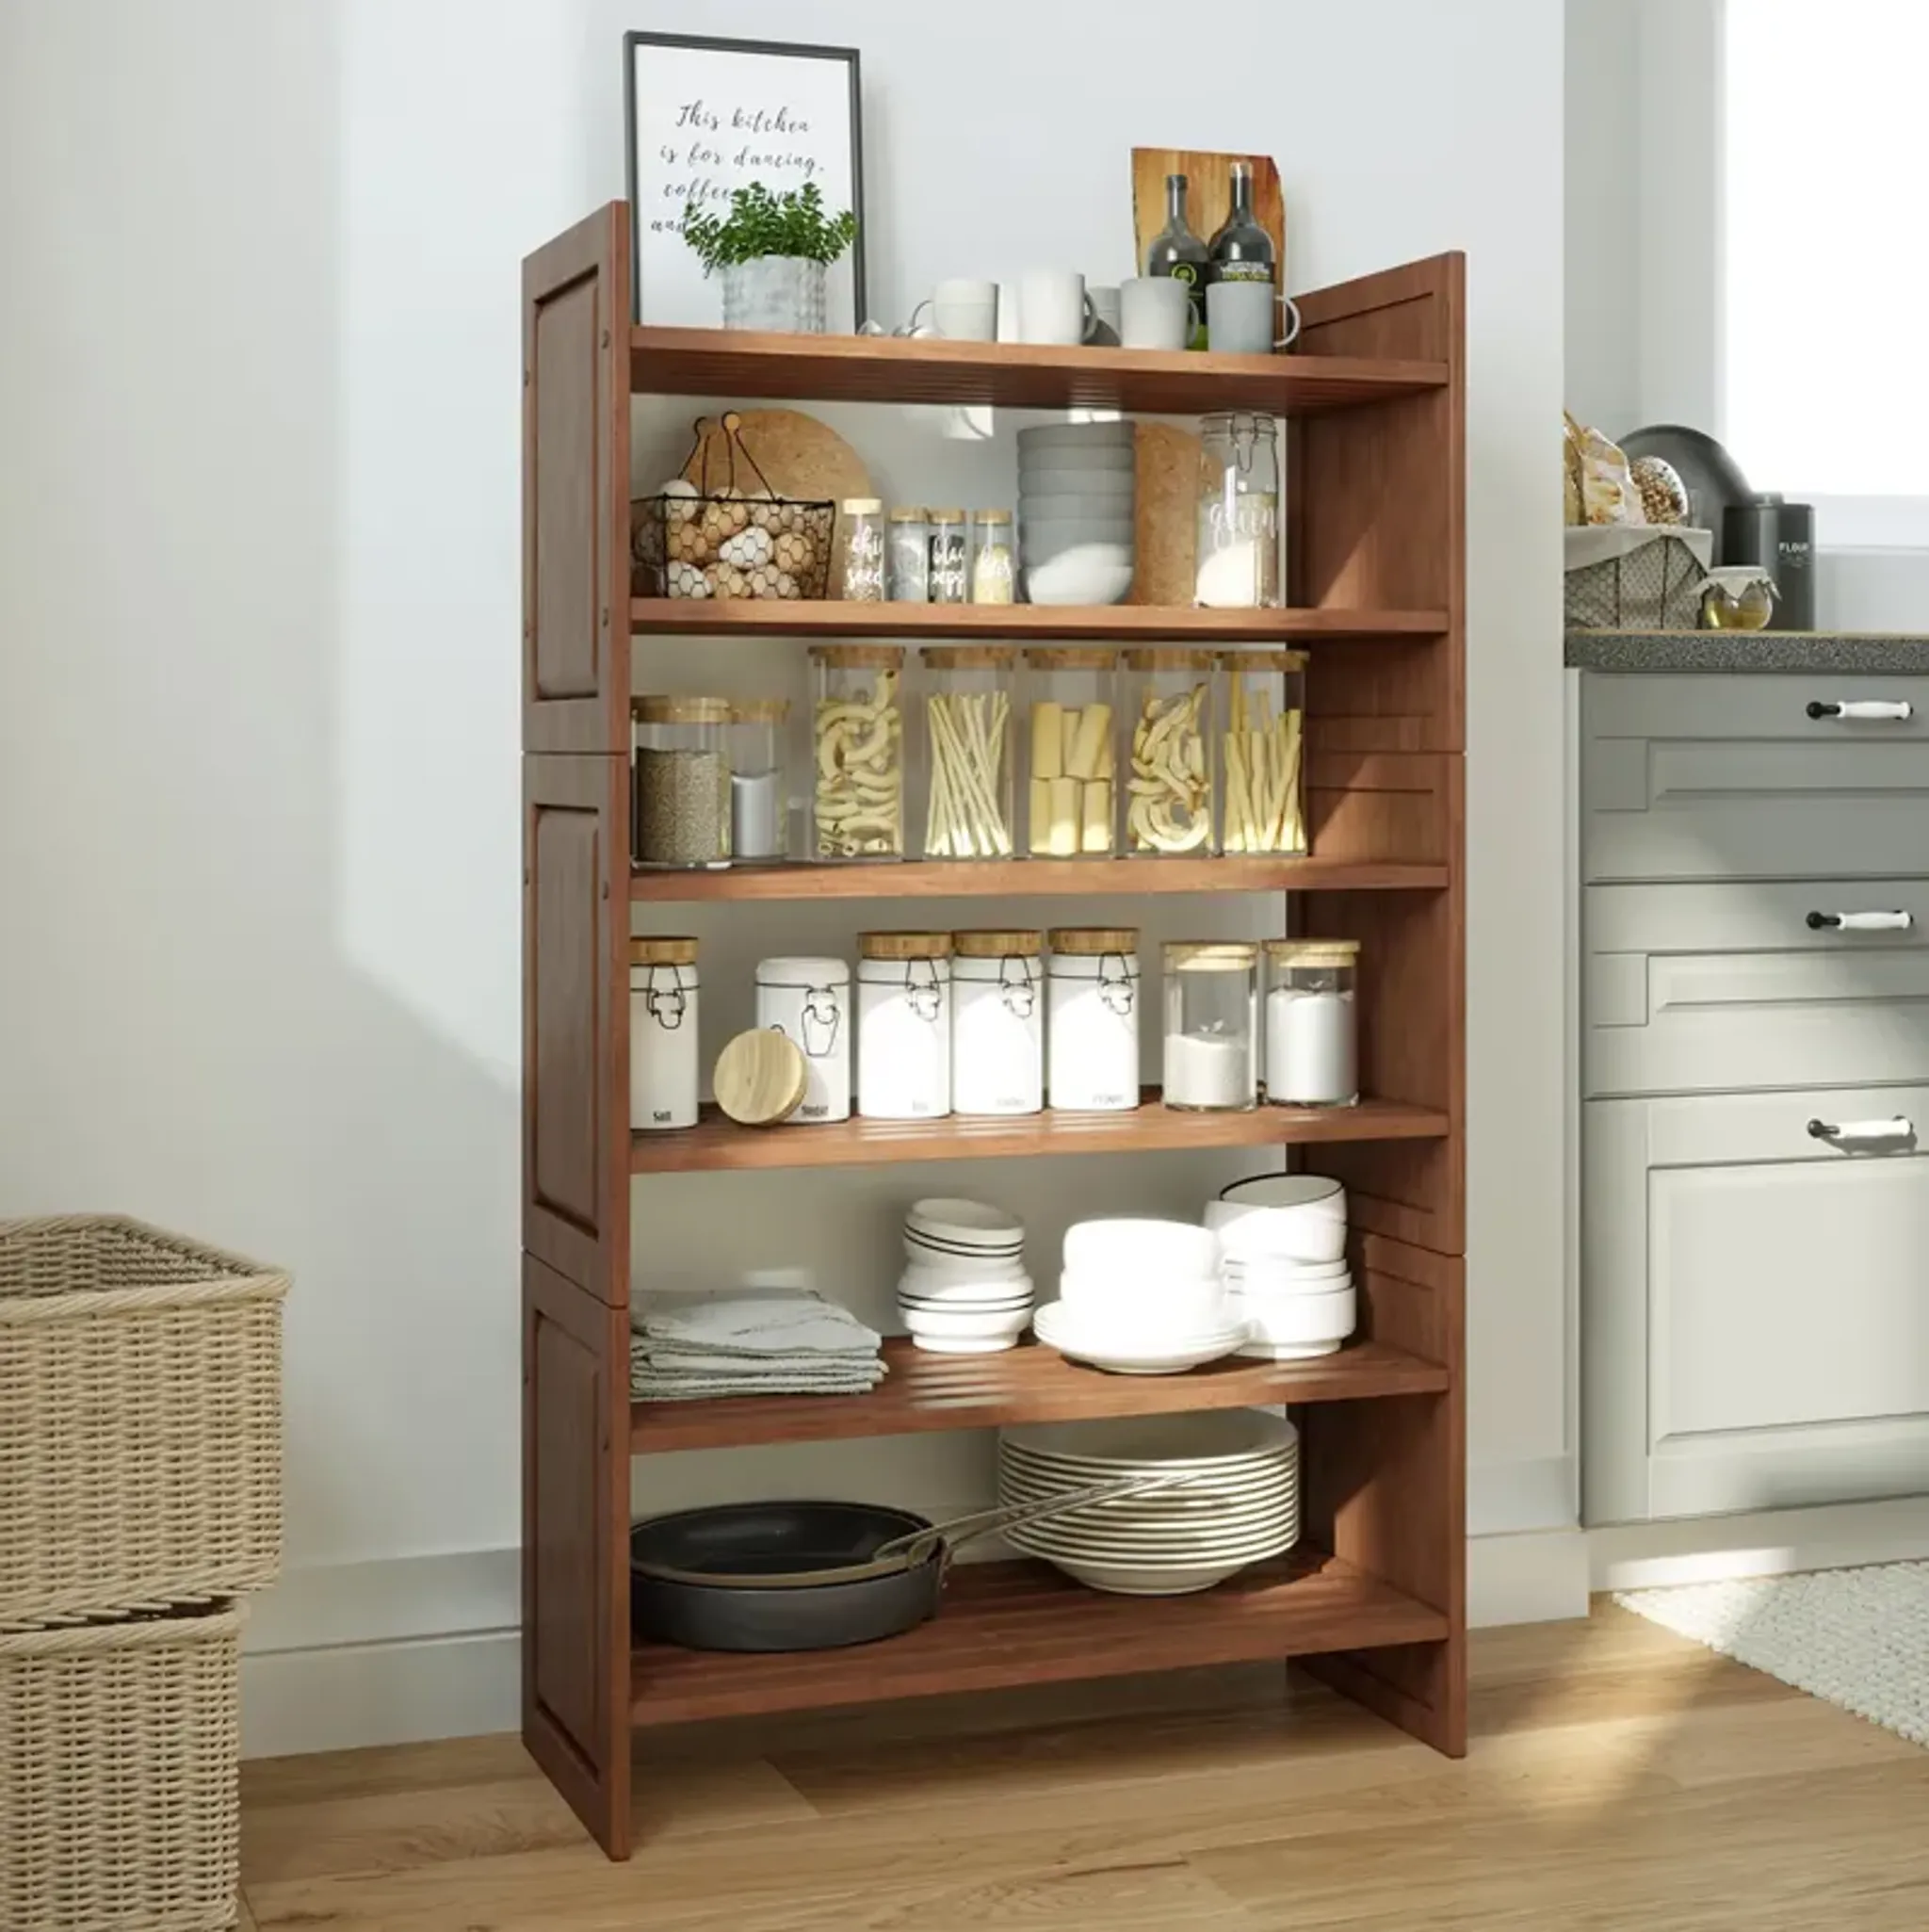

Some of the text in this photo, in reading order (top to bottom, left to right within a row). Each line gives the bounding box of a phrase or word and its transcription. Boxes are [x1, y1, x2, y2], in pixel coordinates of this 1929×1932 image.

[675, 99, 809, 133] This kitchen
[659, 145, 678, 164] is
[688, 142, 721, 168] for
